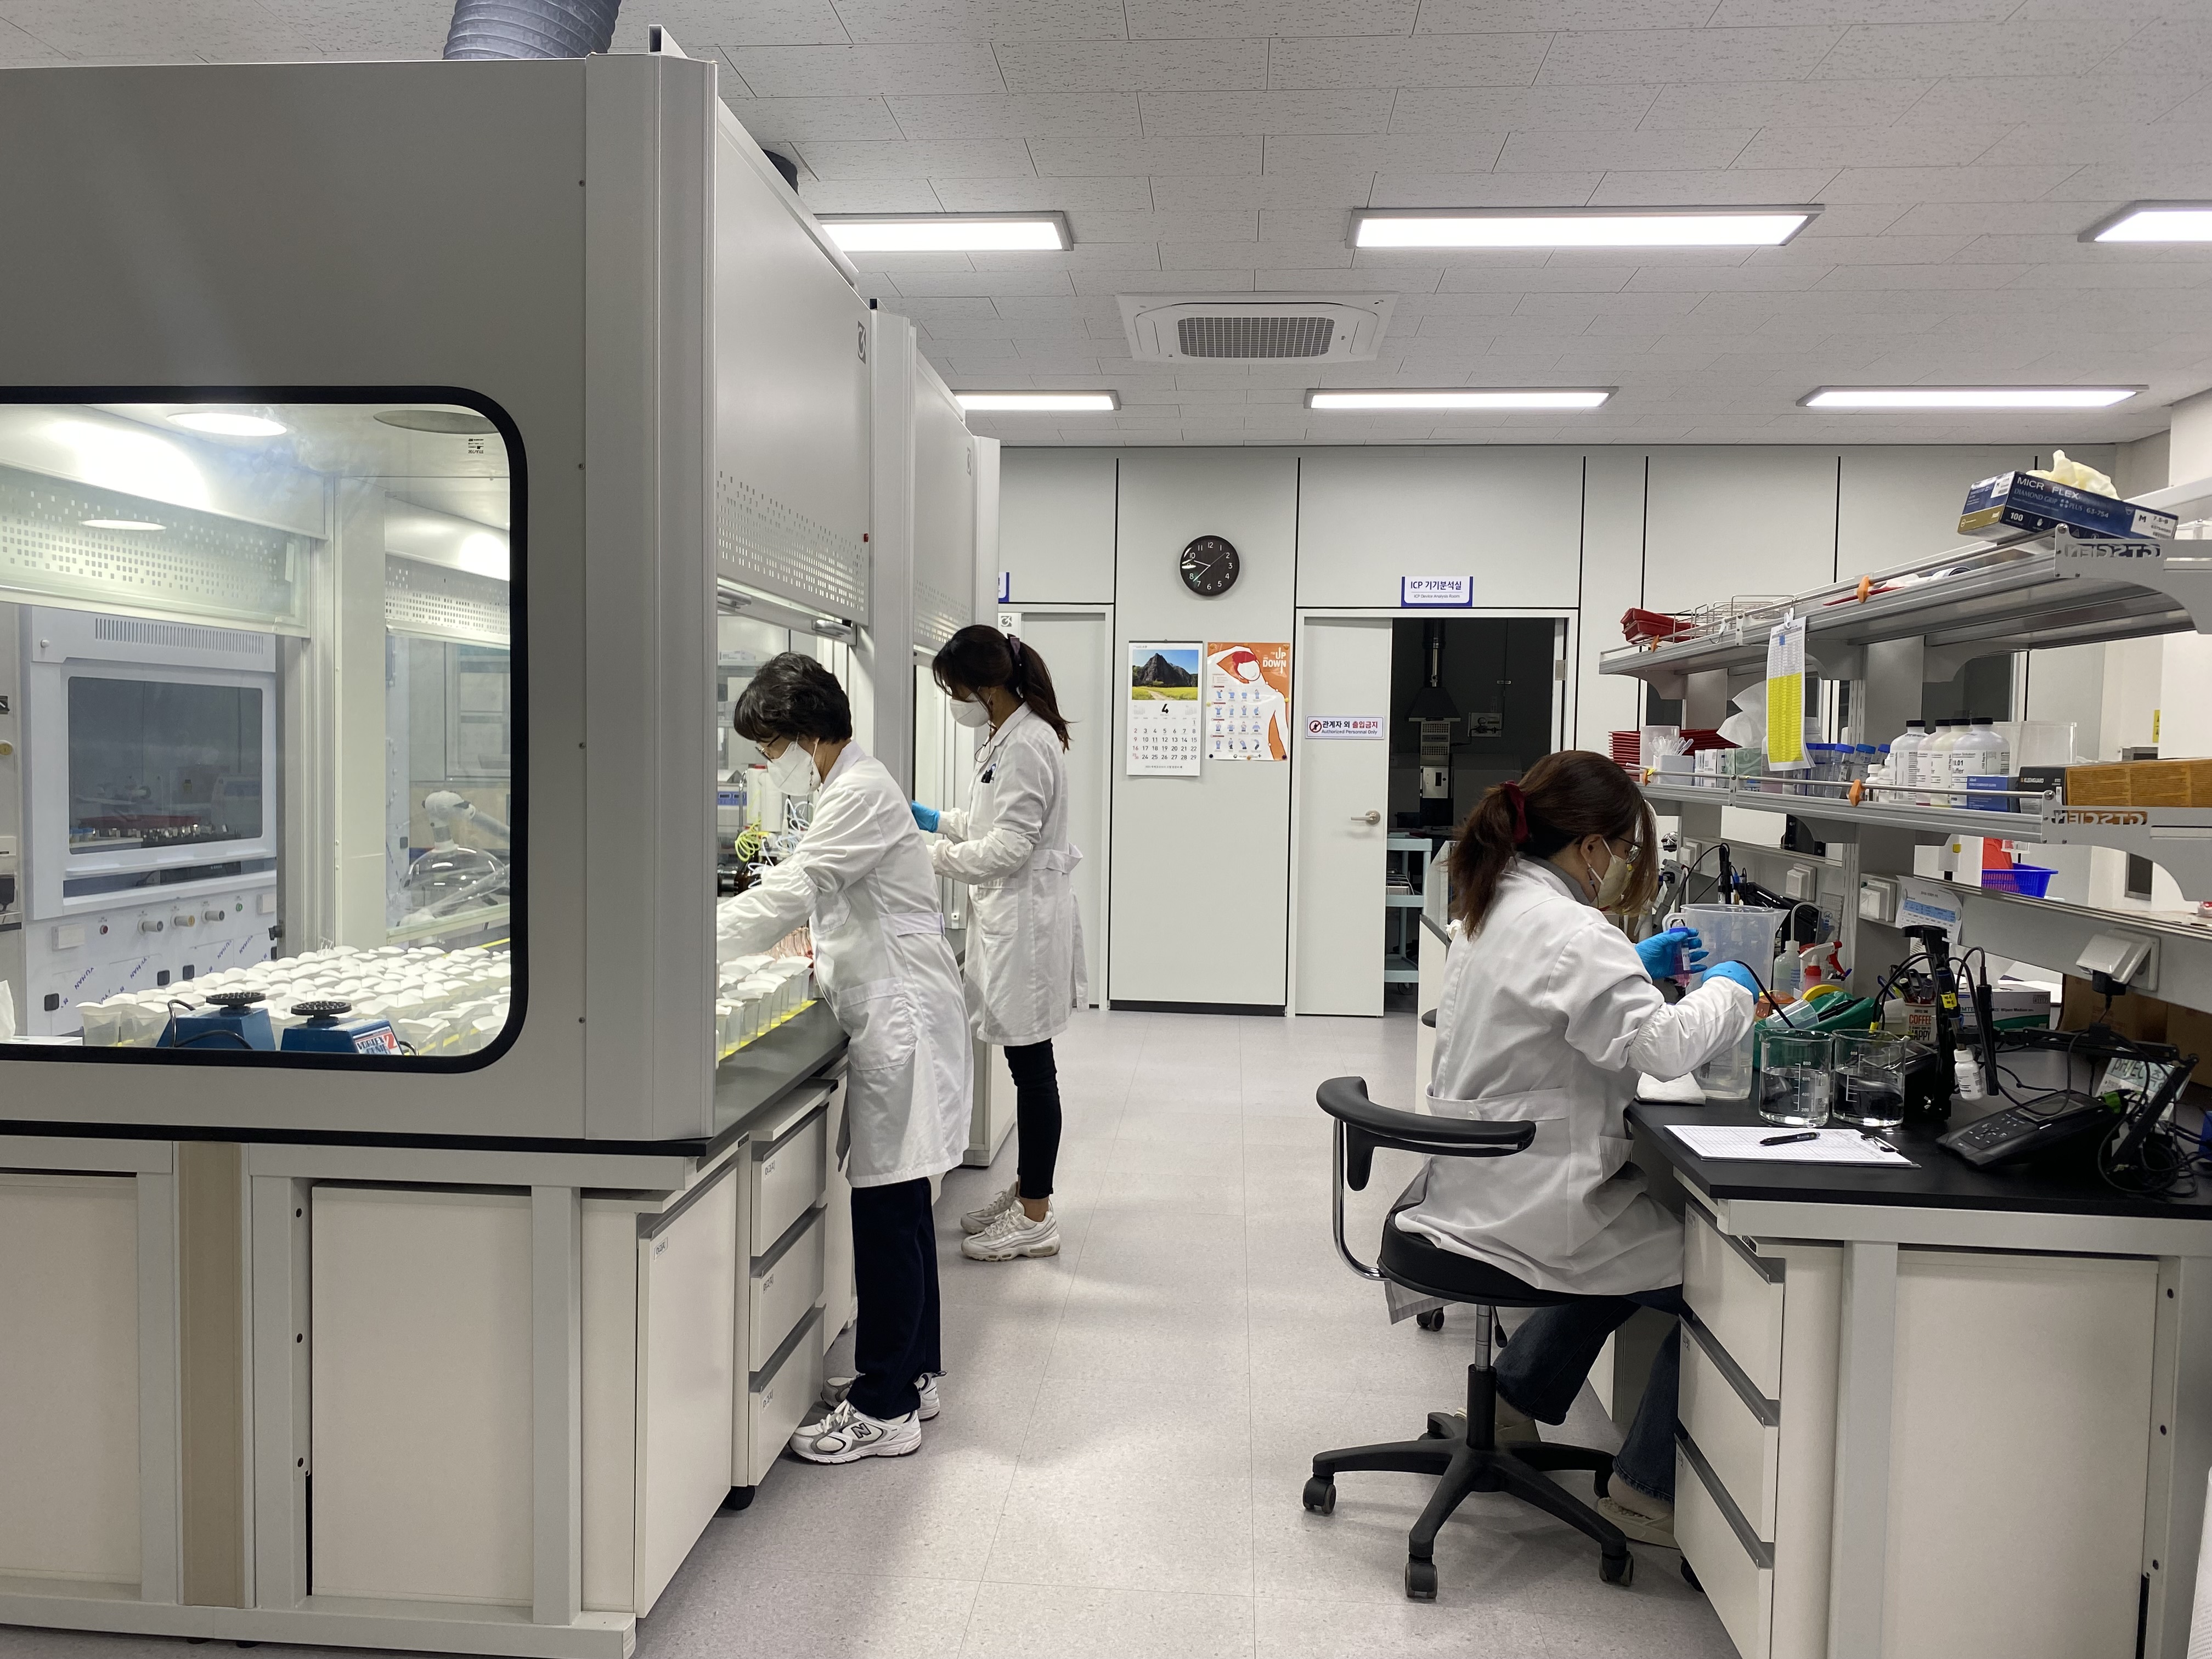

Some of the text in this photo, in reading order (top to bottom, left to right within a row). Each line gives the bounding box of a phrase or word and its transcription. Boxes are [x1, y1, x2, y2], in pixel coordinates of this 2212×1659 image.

[2014, 488, 2044, 500] DIAMOND
[2044, 495, 2058, 504] GRIP
[2069, 503, 2083, 511] PLUS
[2010, 512, 2023, 521] 100
[1425, 581, 1462, 590] 기기분석실
[1263, 660, 1286, 669] DOWN
[1161, 703, 1169, 713] 4
[75, 967, 94, 990] YUHAN
[1909, 1014, 1931, 1024] COFFEE
[851, 1423, 872, 1439] N
